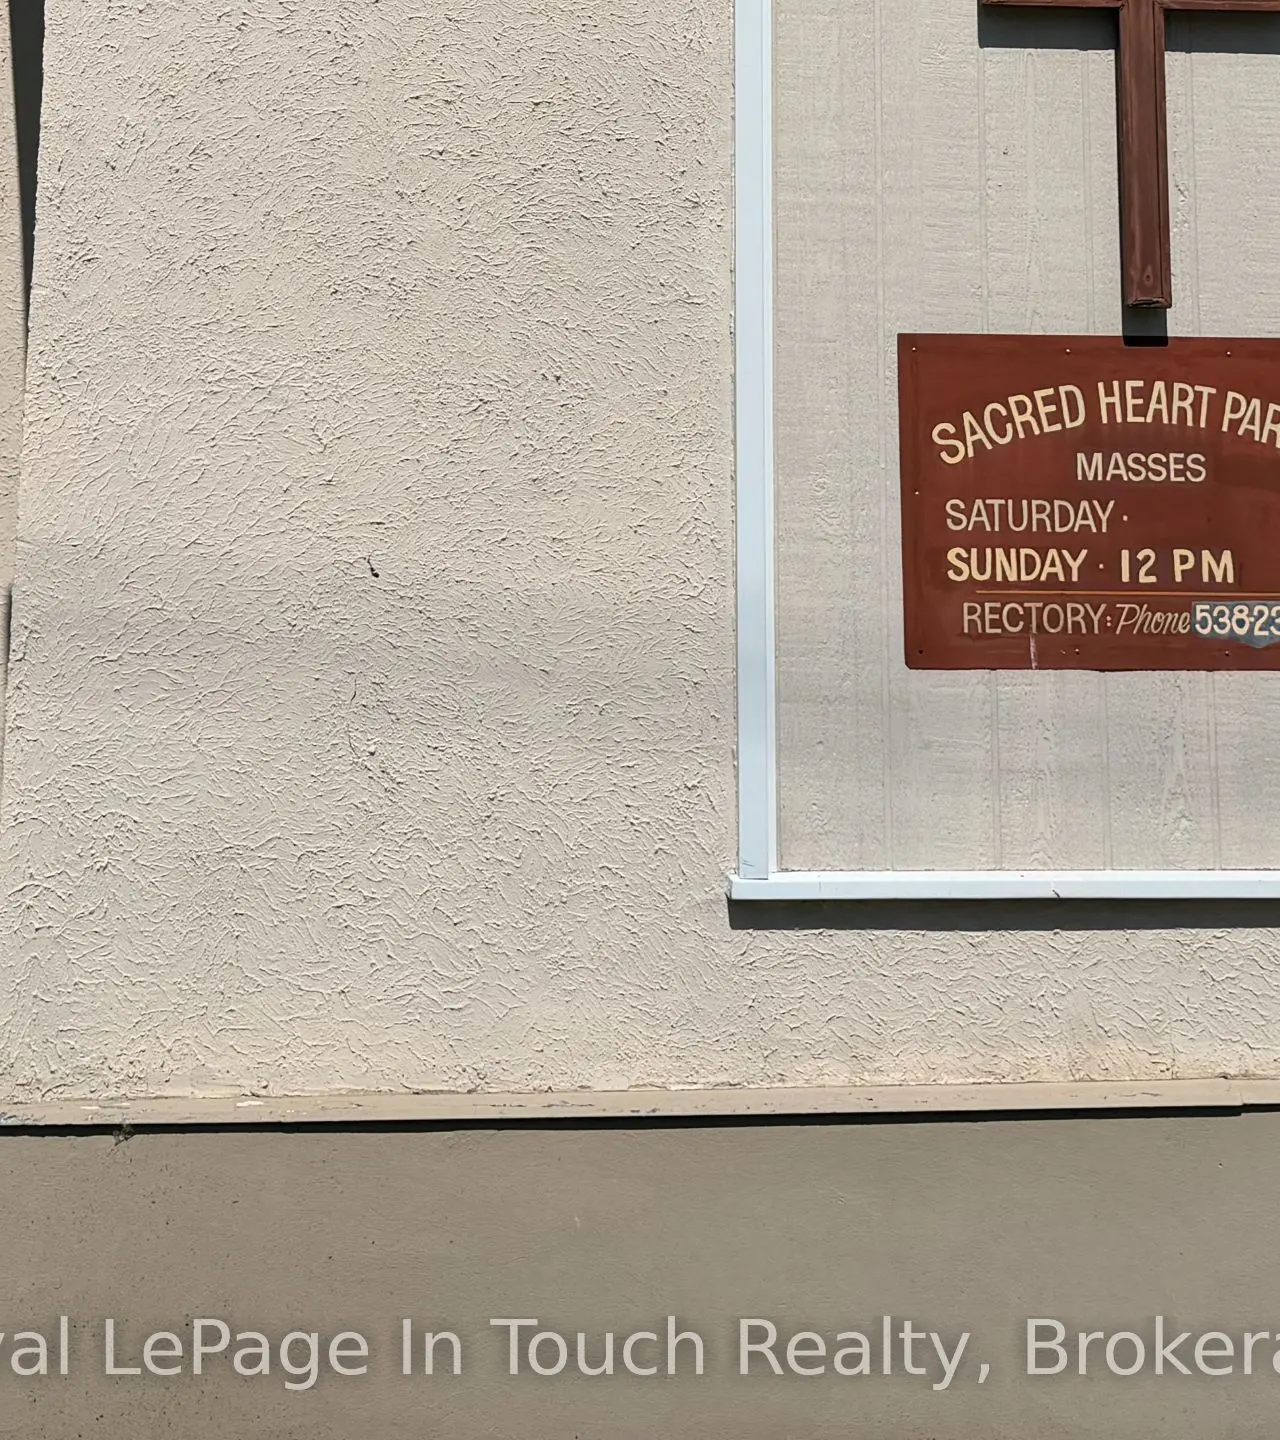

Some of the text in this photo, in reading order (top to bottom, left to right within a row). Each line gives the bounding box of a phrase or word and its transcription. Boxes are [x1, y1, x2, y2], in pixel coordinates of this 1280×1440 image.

[931, 384, 1086, 464] SACRED
[1097, 379, 1217, 428] HEART
[1076, 452, 1206, 482] MASSES
[1120, 548, 1157, 584] 12
[1173, 548, 1235, 584] PM
[1115, 603, 1191, 635] Phone
